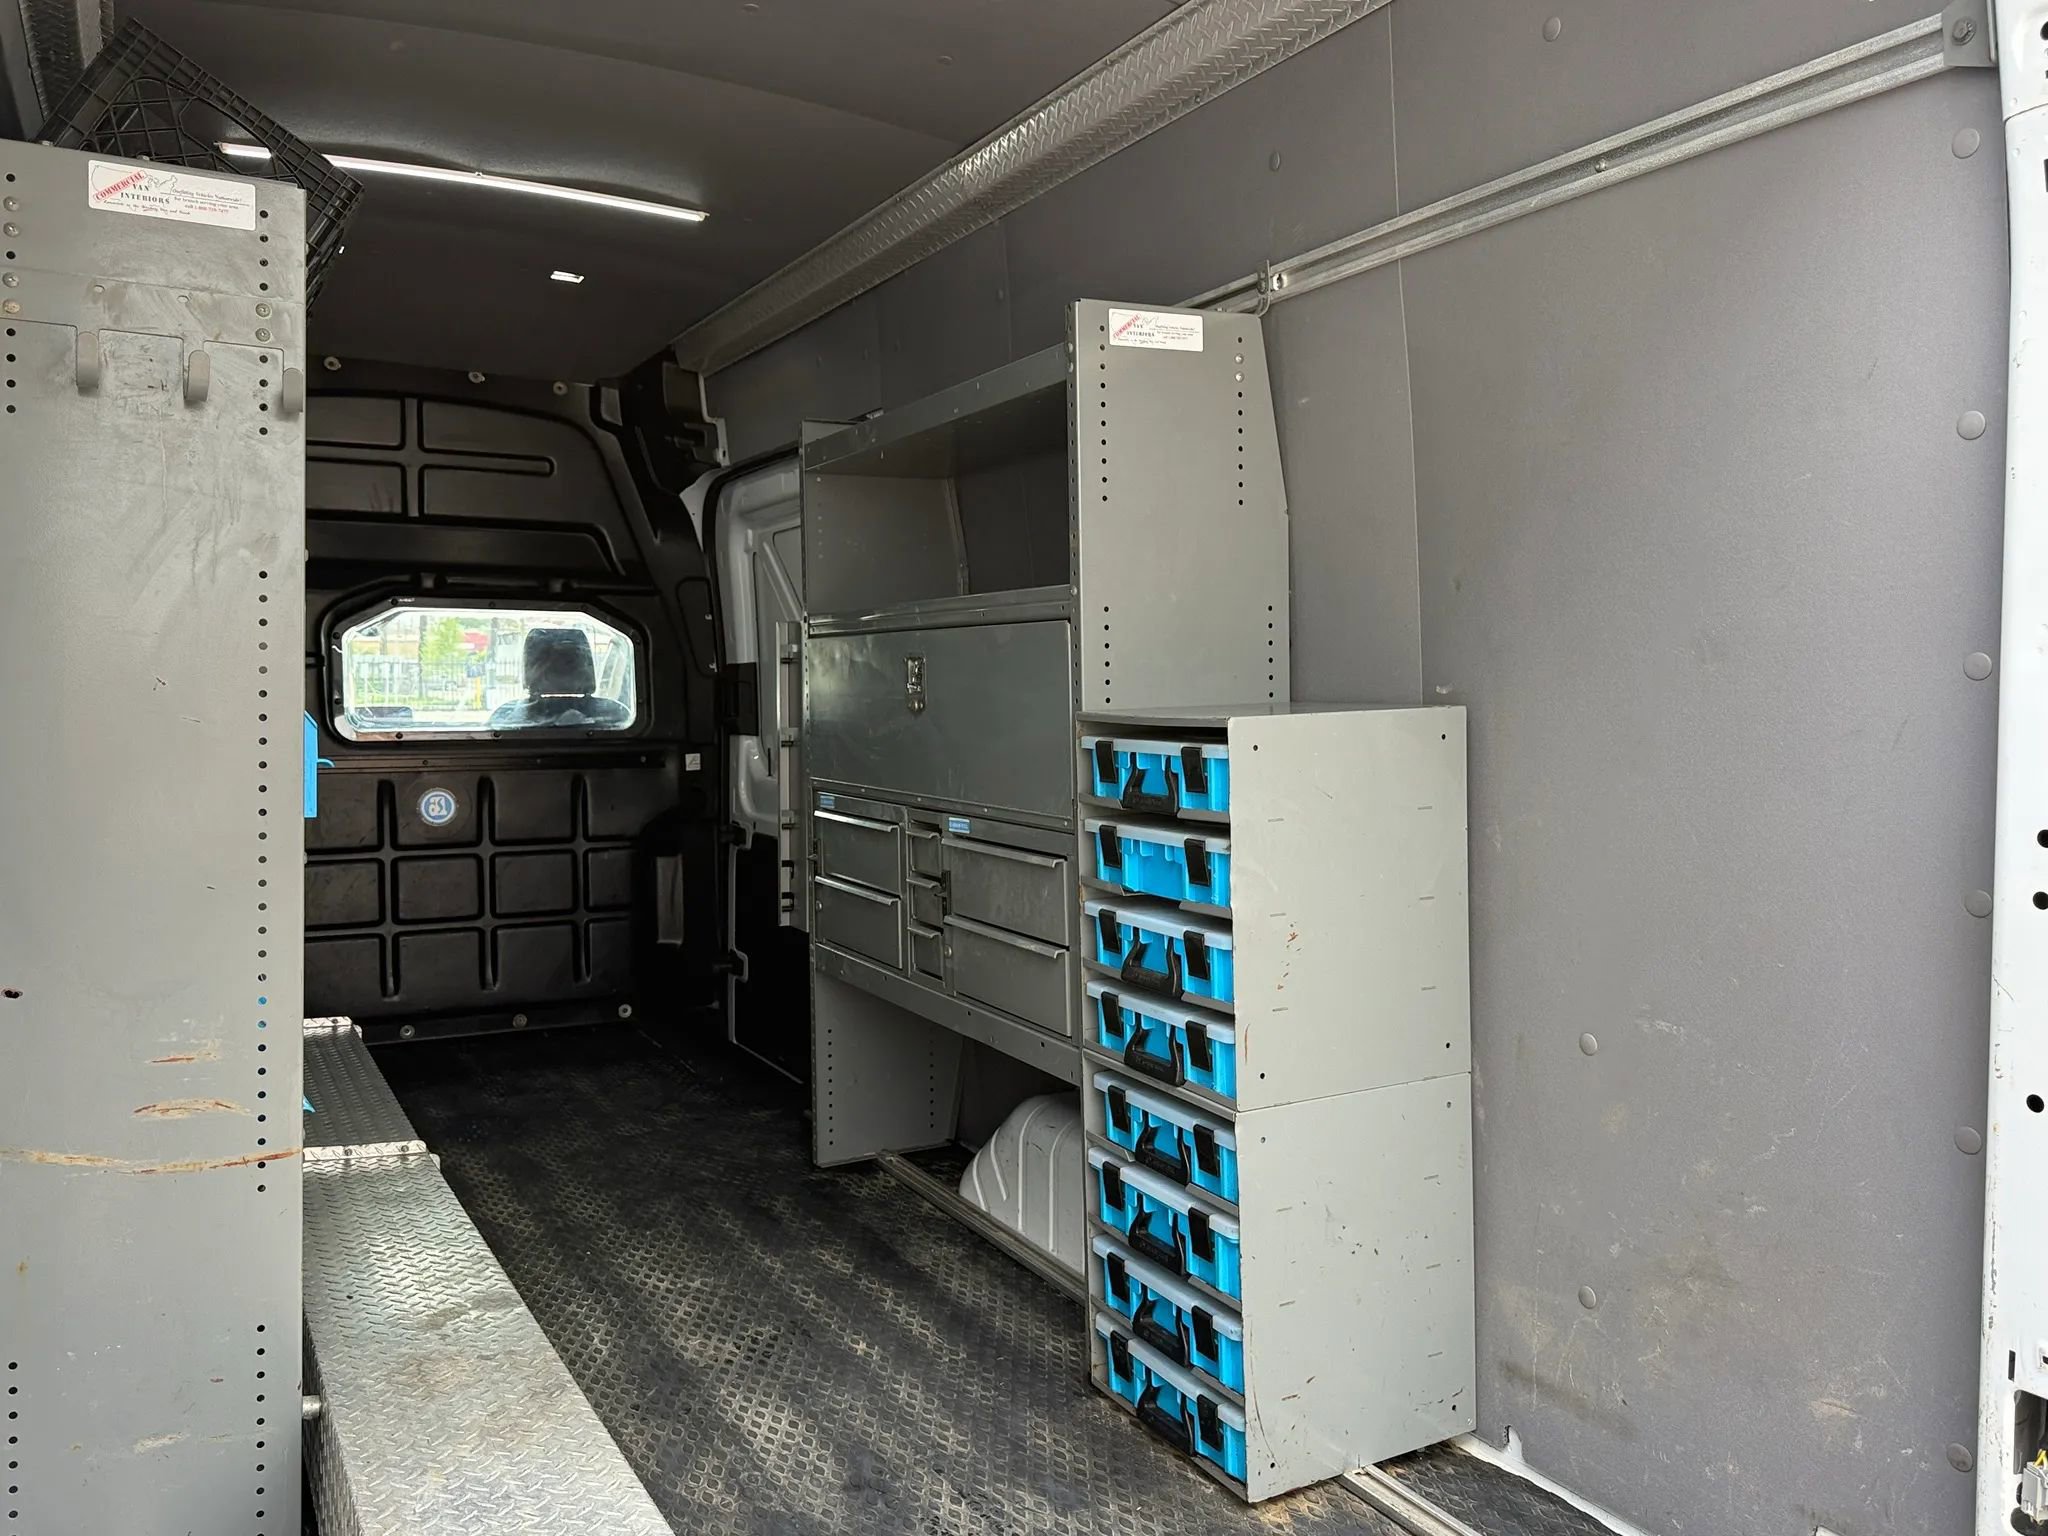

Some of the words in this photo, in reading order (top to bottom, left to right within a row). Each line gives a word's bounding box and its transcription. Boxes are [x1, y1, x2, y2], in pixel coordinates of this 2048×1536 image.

[96, 171, 145, 201] COMMERCIAL
[132, 183, 149, 192] VAN
[120, 192, 170, 204] INTERIORS
[1112, 314, 1141, 339] COMMERCIAL
